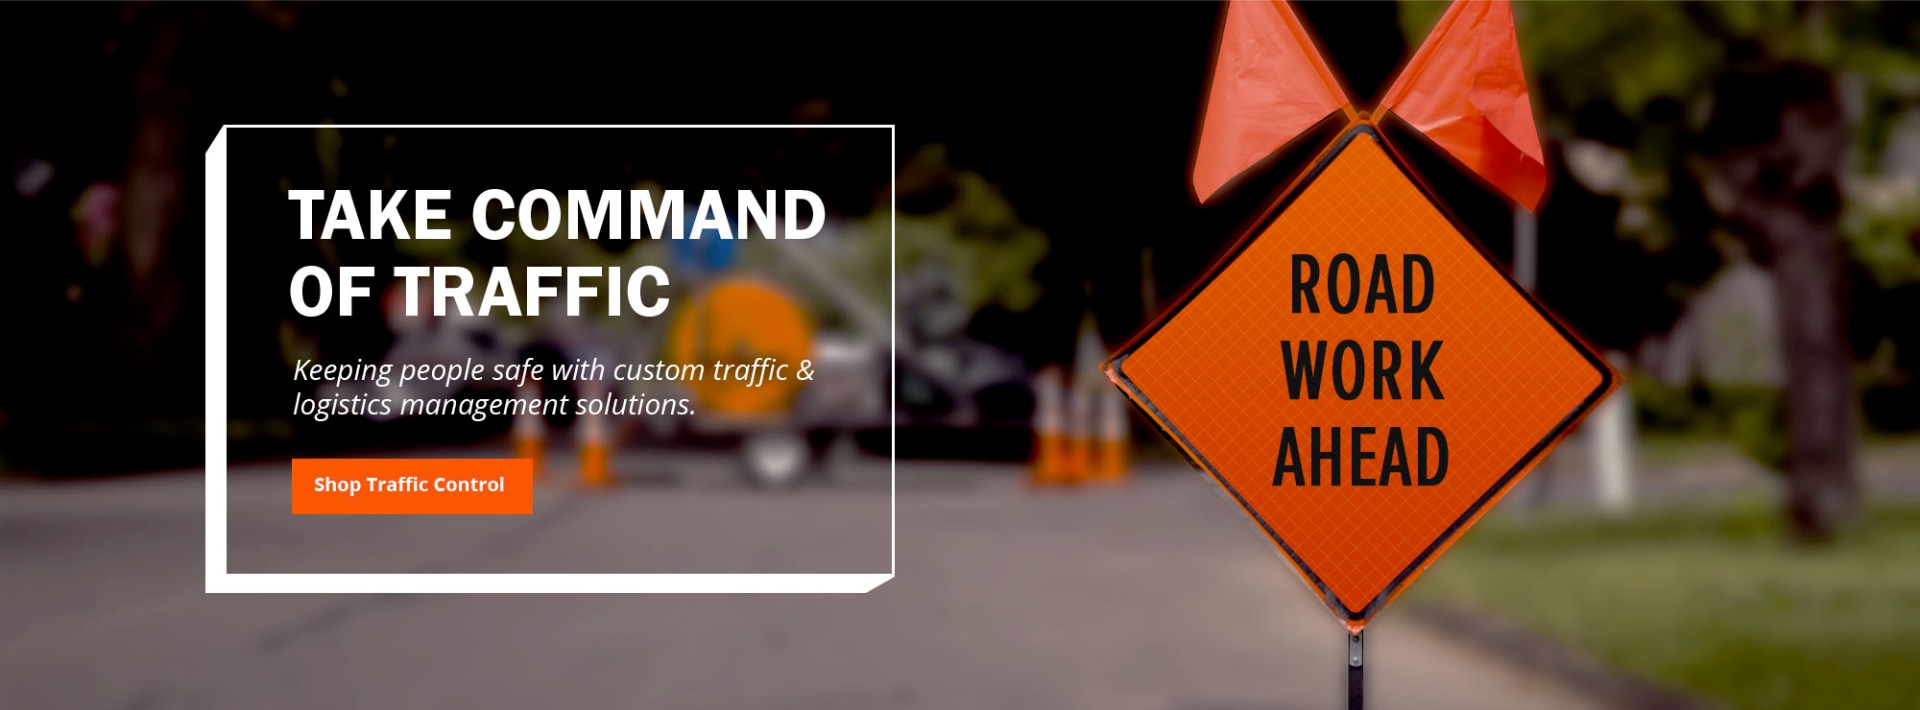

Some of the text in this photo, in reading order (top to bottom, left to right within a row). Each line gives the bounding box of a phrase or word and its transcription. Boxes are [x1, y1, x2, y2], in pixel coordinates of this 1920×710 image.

[1291, 253, 1434, 315] ROAD
[1280, 339, 1445, 401] WORK
[1272, 426, 1449, 487] AHEAD
